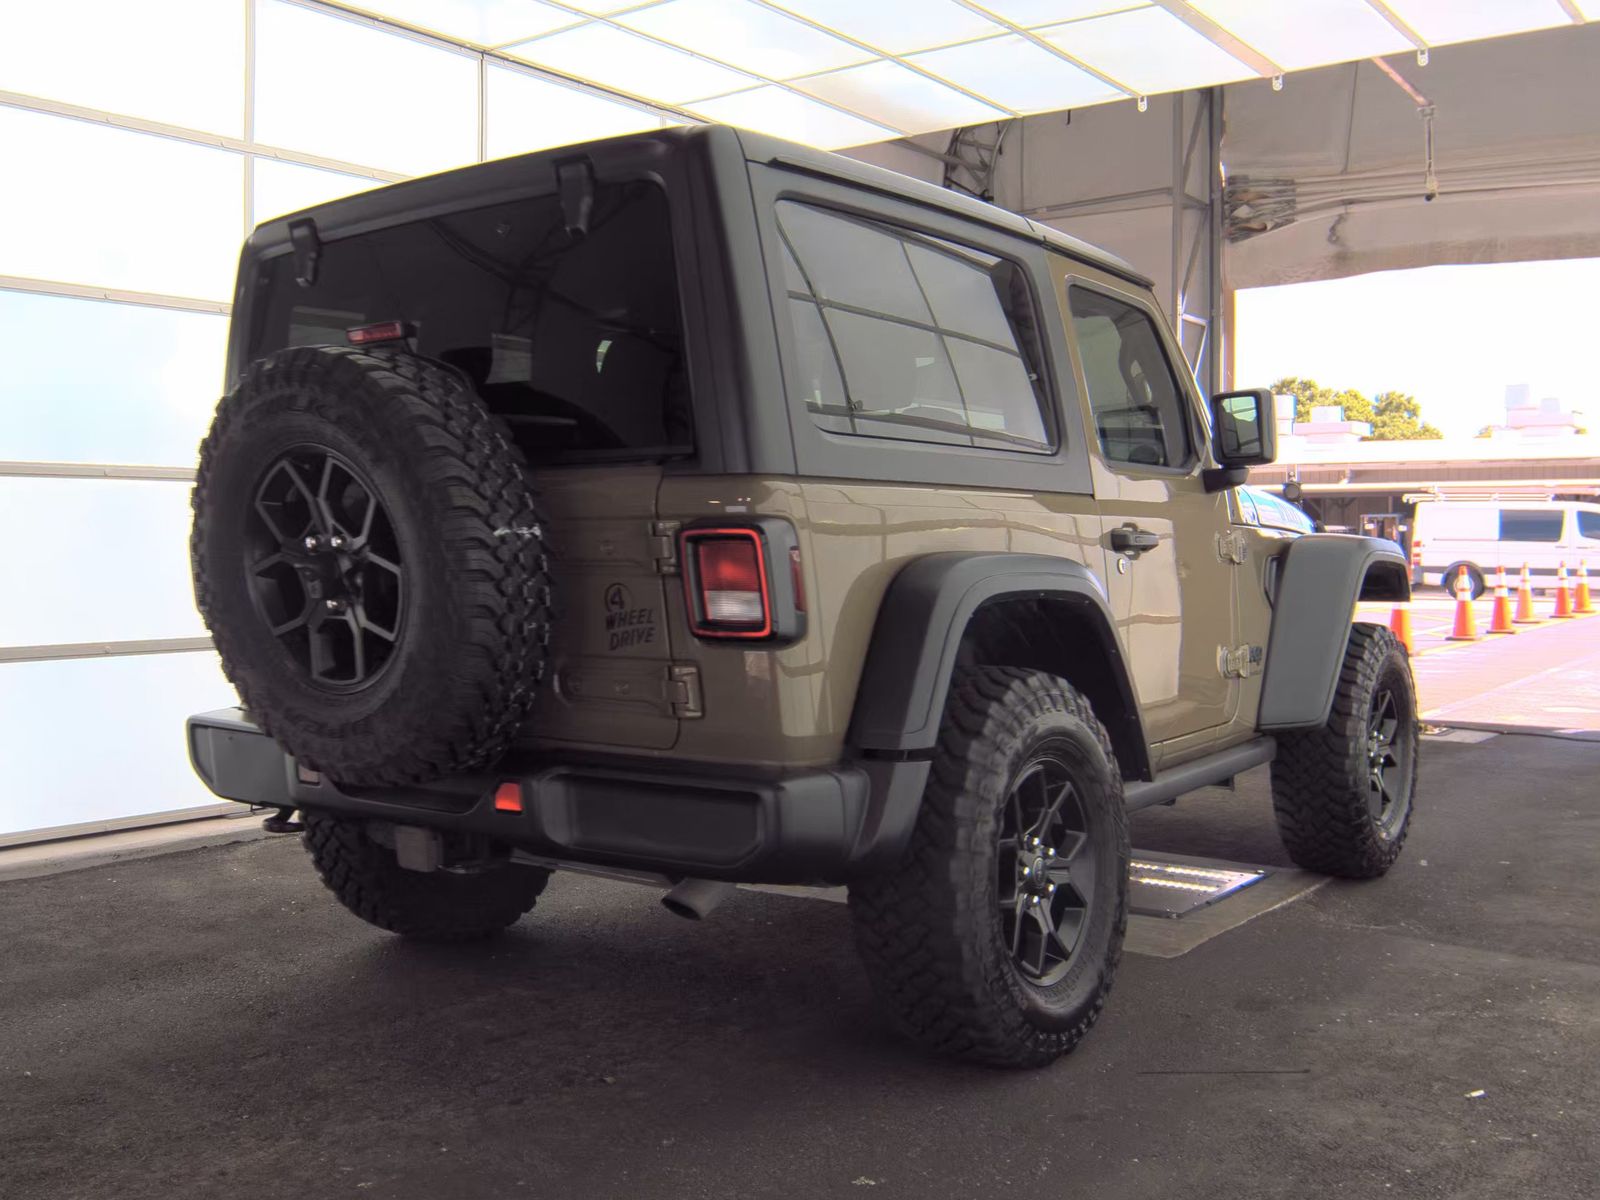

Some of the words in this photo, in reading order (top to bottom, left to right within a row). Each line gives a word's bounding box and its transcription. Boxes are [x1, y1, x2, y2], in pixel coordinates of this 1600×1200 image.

[610, 587, 625, 609] 4
[606, 609, 654, 630] WHEEL
[610, 628, 654, 650] DRIVE
